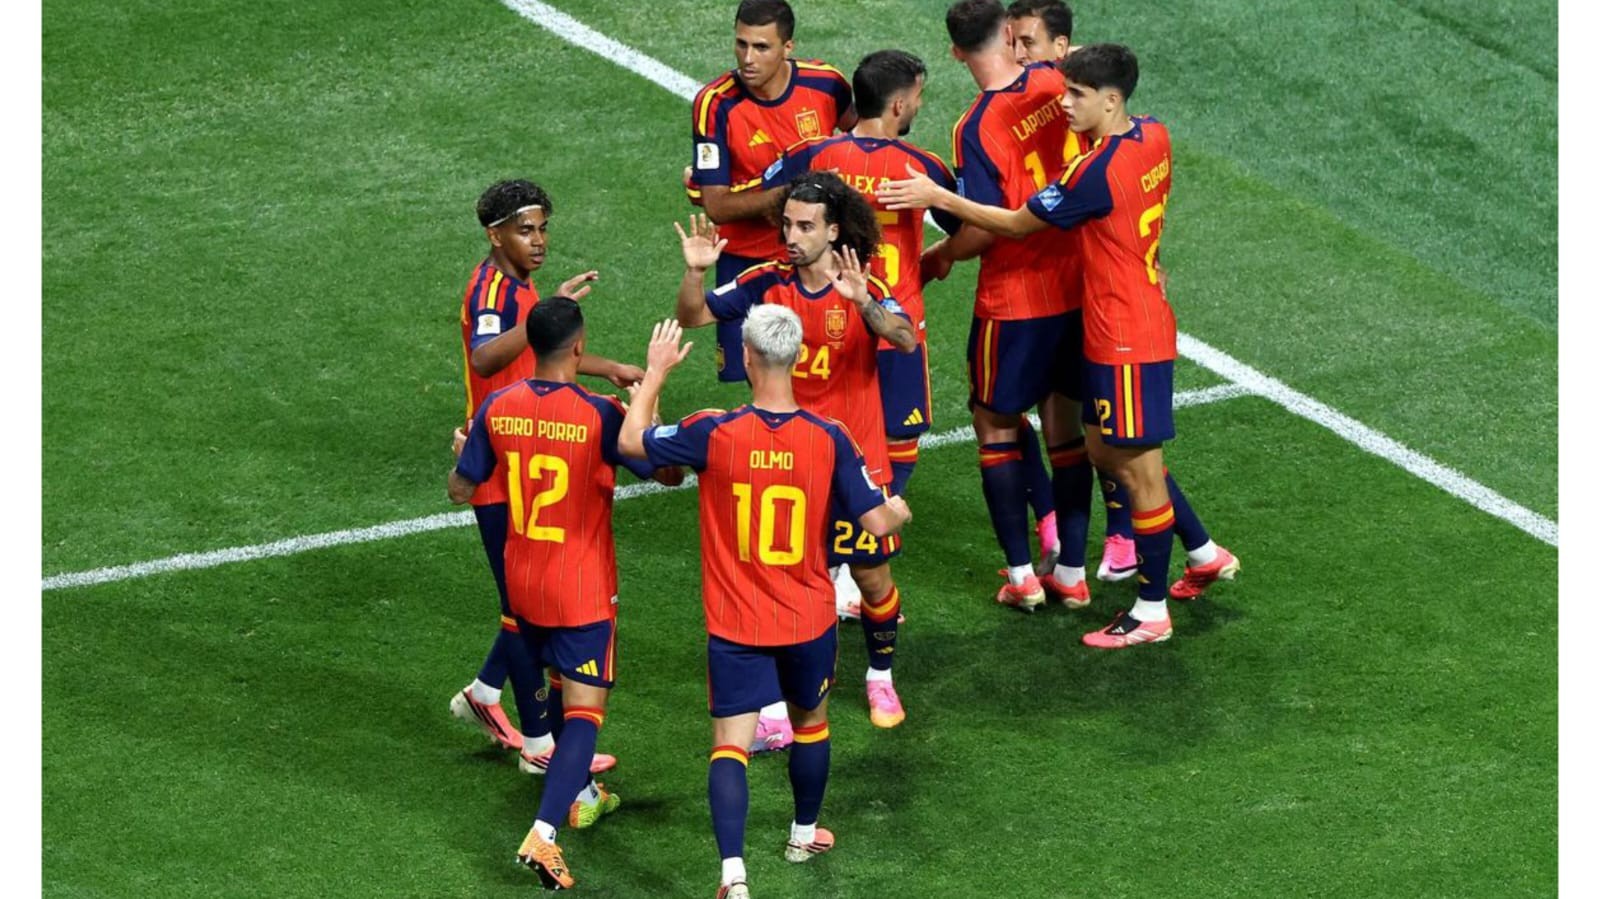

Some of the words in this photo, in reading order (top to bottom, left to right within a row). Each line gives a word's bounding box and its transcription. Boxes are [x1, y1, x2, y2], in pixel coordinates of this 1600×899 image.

[1139, 193, 1168, 285] 2
[791, 343, 831, 380] 24
[490, 416, 533, 436] PEDRO
[538, 419, 588, 443] PORRO
[750, 450, 794, 470] OLMO
[505, 451, 569, 544] 12
[732, 482, 807, 565] 10
[834, 520, 879, 555] 24
